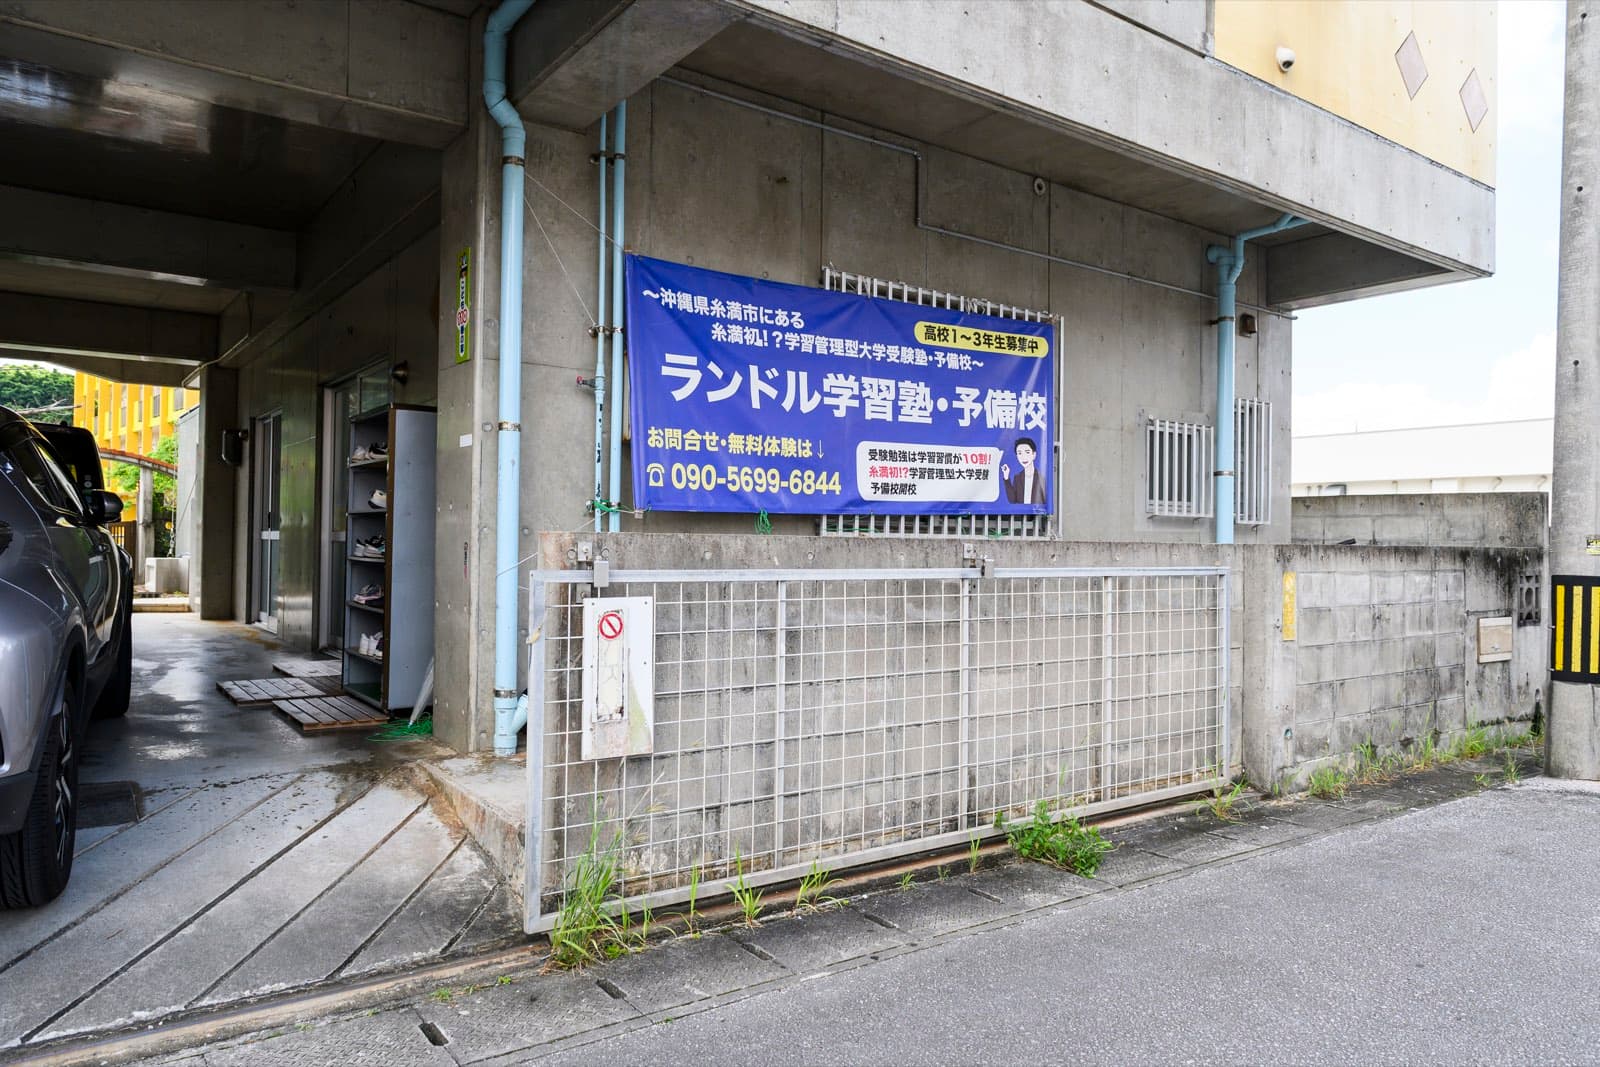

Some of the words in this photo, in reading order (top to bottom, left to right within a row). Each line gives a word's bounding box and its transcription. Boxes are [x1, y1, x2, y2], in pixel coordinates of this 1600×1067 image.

[924, 325, 1038, 353] 高校1～3年生募集中
[661, 354, 1047, 430] ランドル学習塾・予備校
[647, 427, 812, 457] お問合せ・無料体験は
[672, 462, 841, 495] 090-5699-6844
[871, 482, 916, 495] 予備校開校
